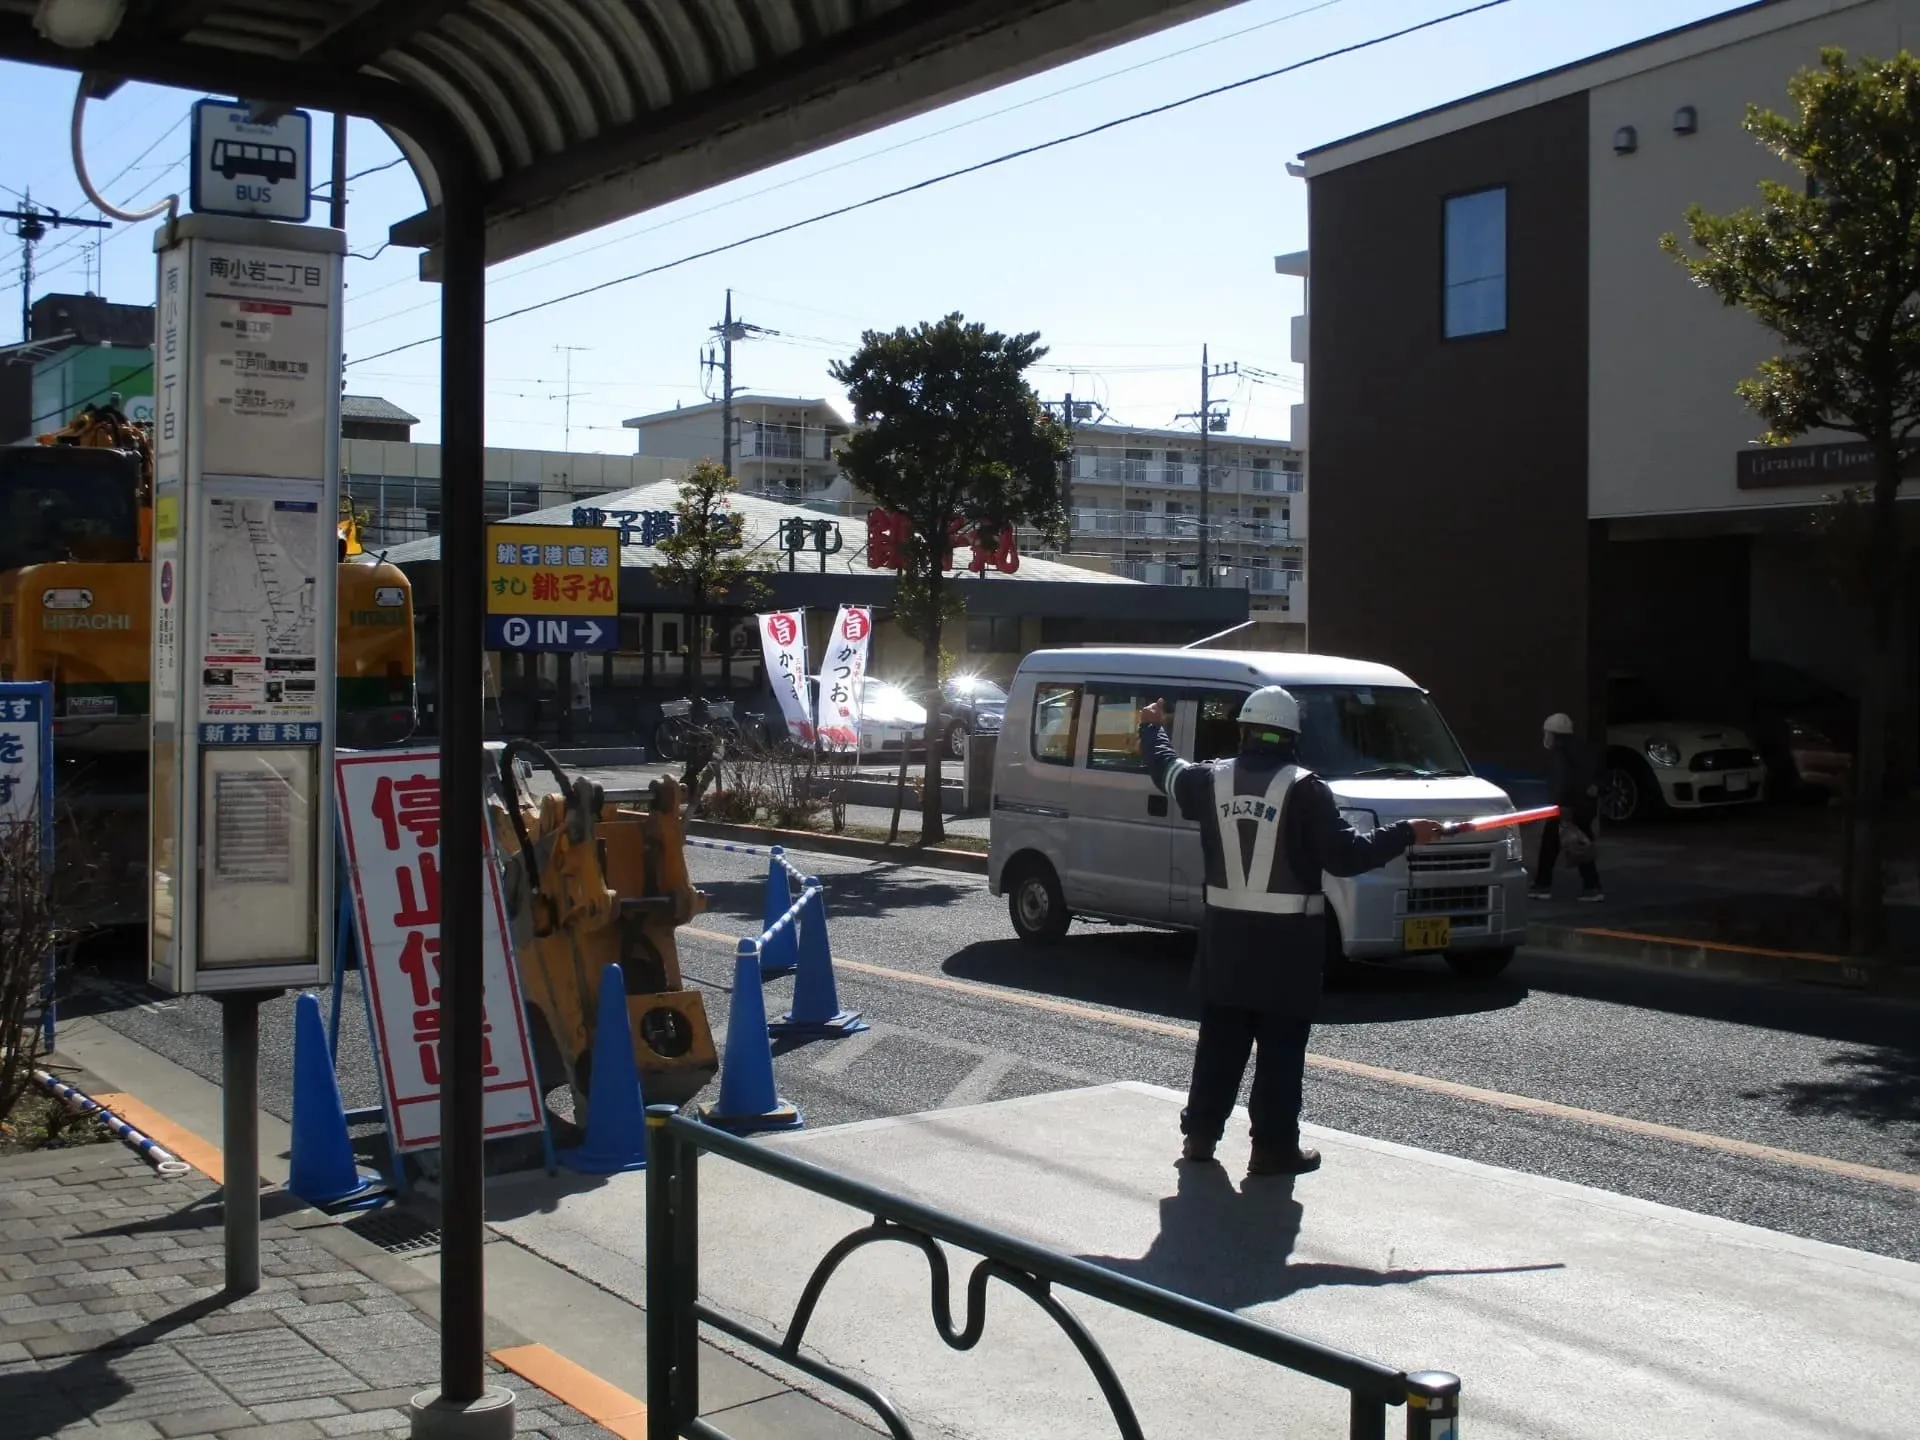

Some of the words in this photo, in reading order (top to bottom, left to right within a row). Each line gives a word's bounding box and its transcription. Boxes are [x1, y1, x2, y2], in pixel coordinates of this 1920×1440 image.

[236, 185, 272, 203] BUS
[209, 257, 321, 287] 南小岩二丁目
[164, 266, 179, 440] 南小岩二丁目
[496, 543, 610, 567] 銚子港直送
[492, 576, 528, 596] すし
[532, 571, 614, 601] 銚子丸
[42, 614, 131, 631] HITACHI
[537, 620, 568, 644] IN
[772, 616, 792, 644] 旨
[845, 612, 862, 639] 旨
[830, 645, 857, 703] かつお
[205, 723, 318, 742] 新井歯科前
